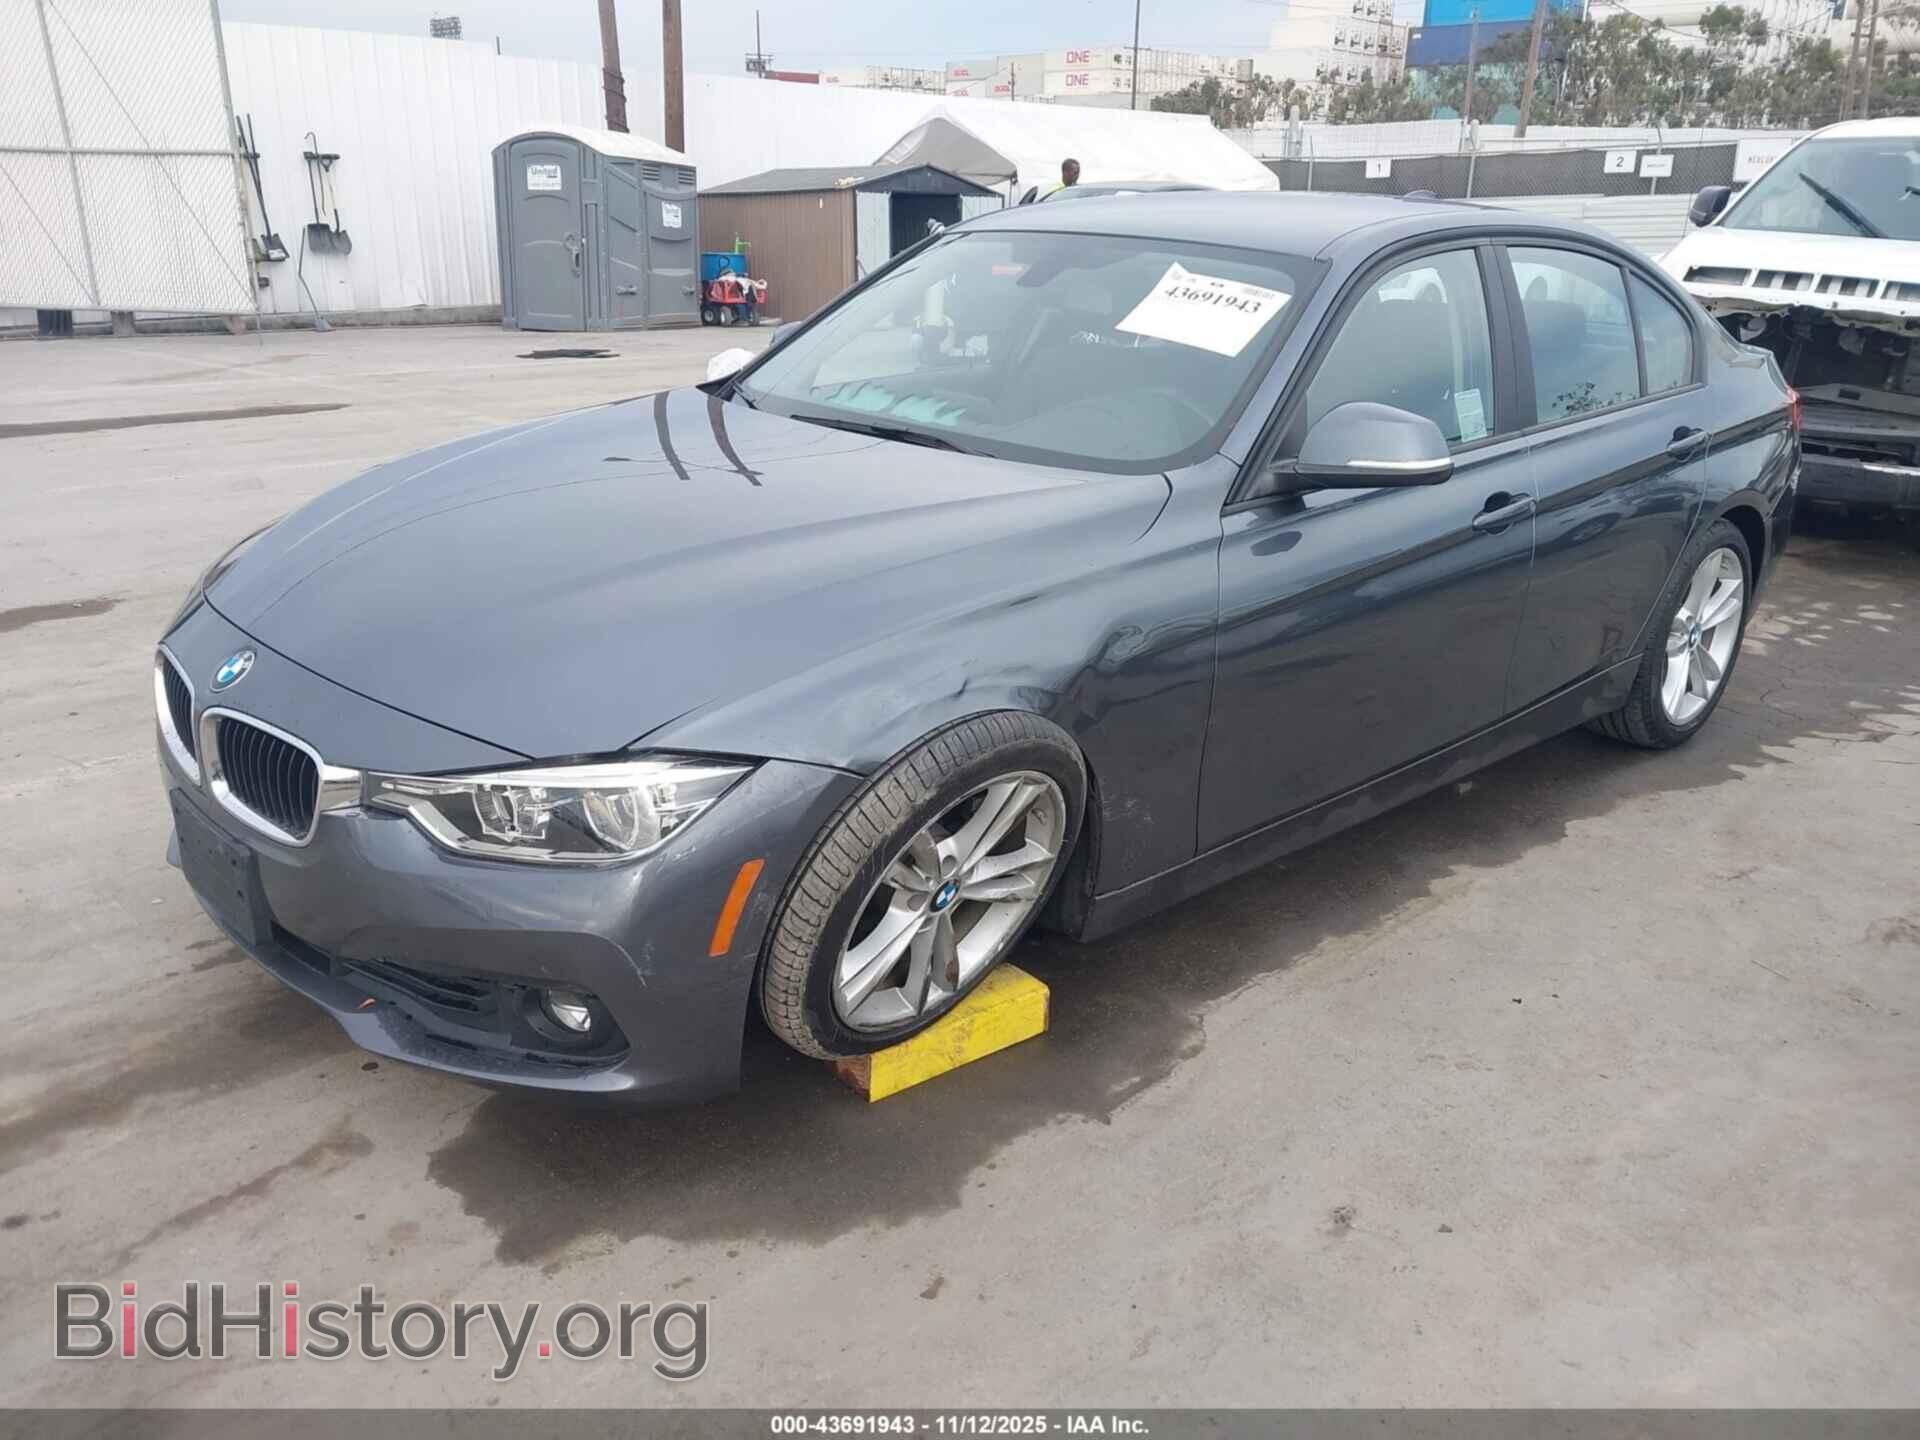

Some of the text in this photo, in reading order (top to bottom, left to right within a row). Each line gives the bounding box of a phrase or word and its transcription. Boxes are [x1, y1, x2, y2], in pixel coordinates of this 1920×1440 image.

[1066, 50, 1090, 63] ONE
[1065, 73, 1089, 86] ONE
[1616, 157, 1625, 167] 2
[1165, 286, 1262, 312] 43691943
